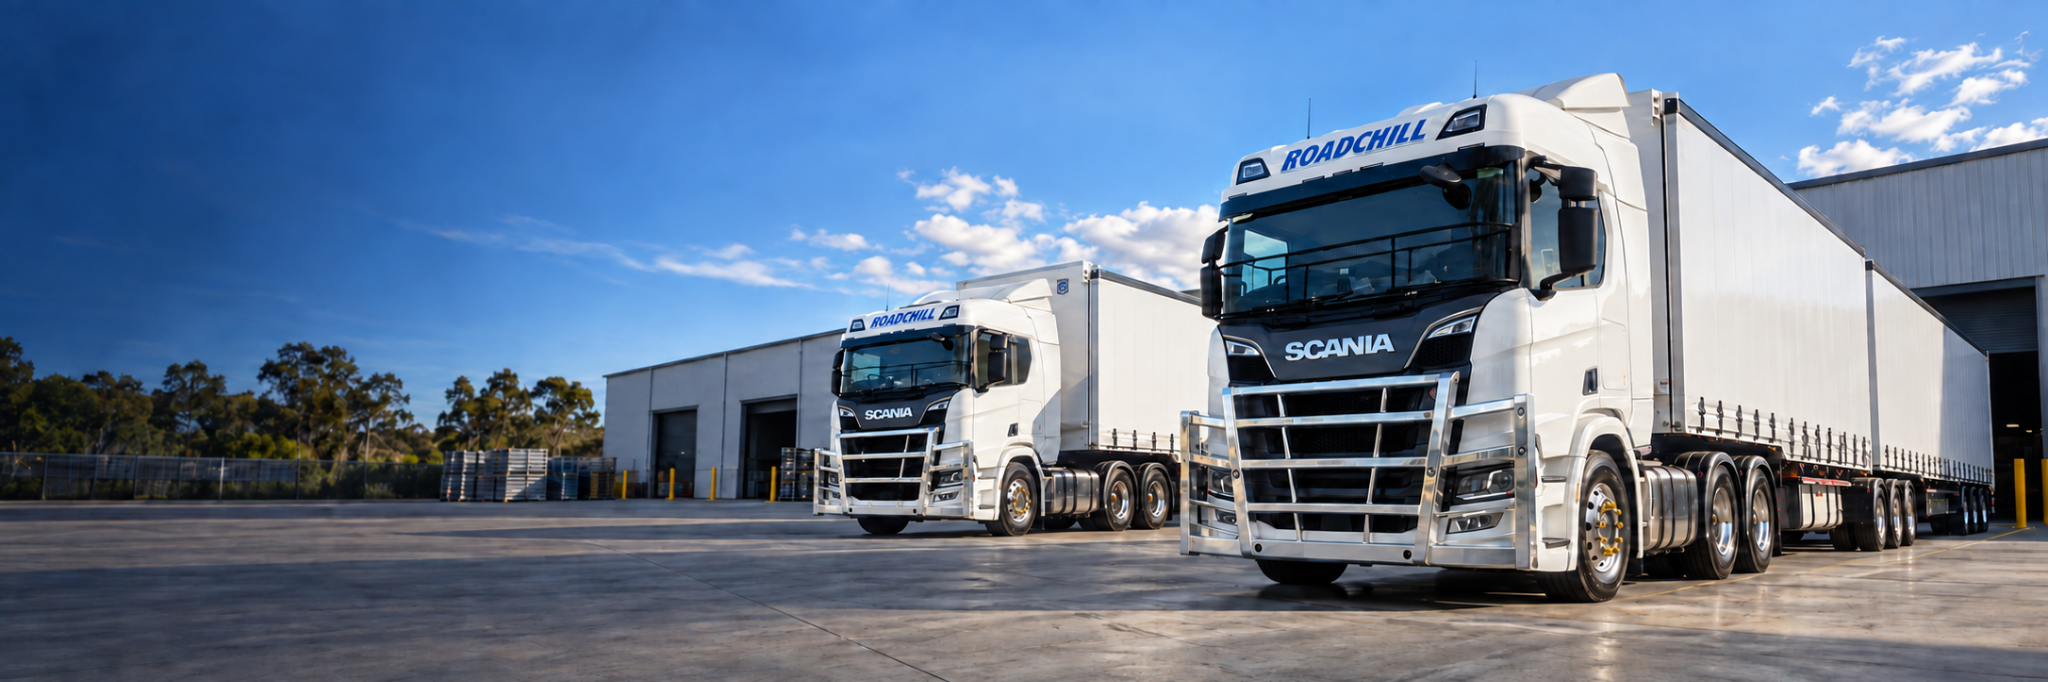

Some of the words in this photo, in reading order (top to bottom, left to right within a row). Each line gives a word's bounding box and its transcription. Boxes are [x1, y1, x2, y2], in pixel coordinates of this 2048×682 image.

[1281, 118, 1427, 172] ROADCHILL
[870, 307, 935, 329] ROADCHILL
[1285, 333, 1395, 361] SCANIA
[865, 407, 913, 420] SCANIA
